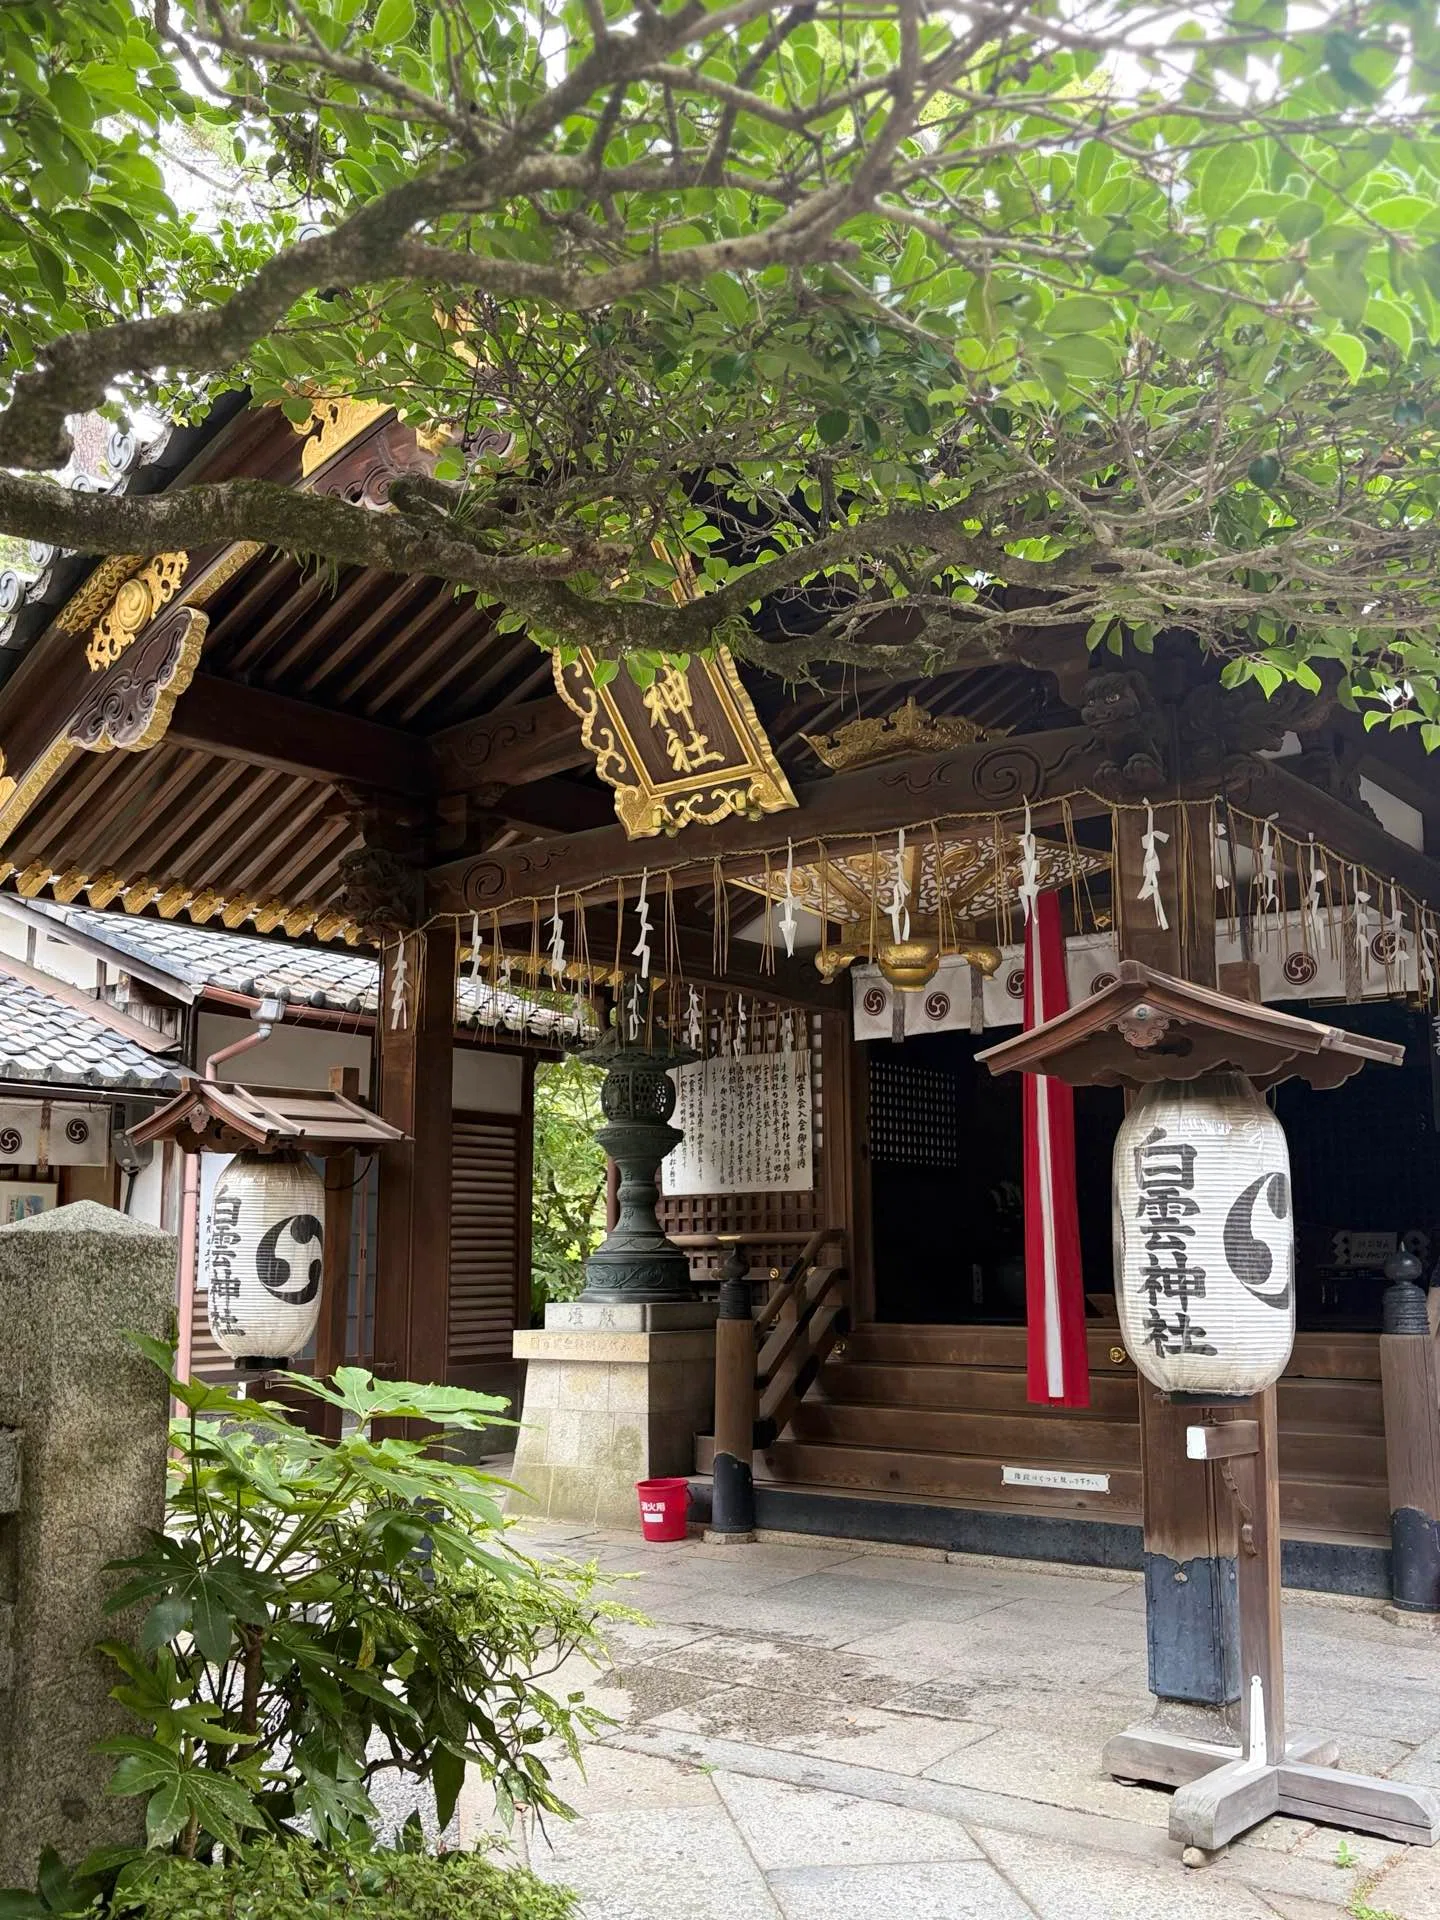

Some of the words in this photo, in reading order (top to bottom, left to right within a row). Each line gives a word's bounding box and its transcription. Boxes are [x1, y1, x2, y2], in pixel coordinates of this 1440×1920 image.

[210, 1185, 246, 1336] 白雲神社
[1133, 1126, 1217, 1359] 白雲神社
